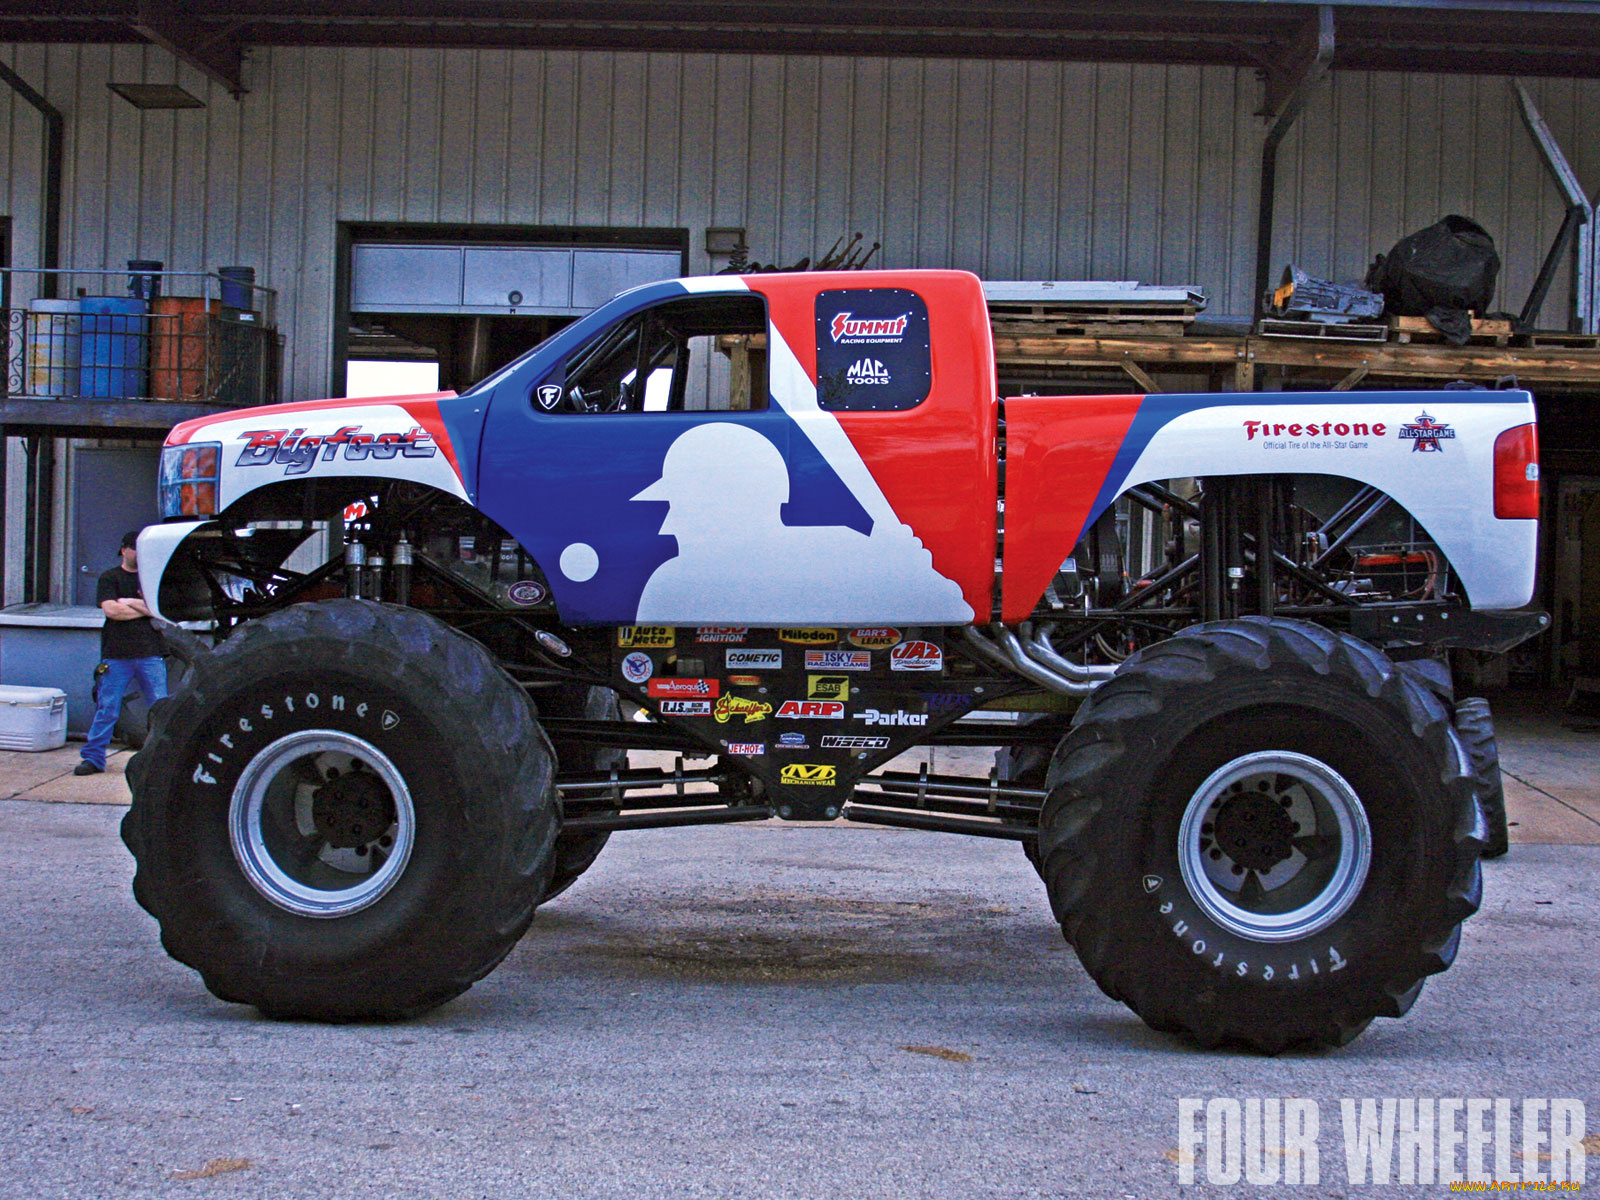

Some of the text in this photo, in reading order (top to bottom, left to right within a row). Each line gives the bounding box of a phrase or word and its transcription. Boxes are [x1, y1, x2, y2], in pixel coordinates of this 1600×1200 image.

[847, 358, 889, 377] MAC
[847, 377, 889, 385] TOOLS
[1243, 420, 1387, 441] Firestone
[1433, 428, 1454, 438] GAME
[235, 425, 437, 475] Bigfoot
[1263, 441, 1369, 450] Official Tire of the All-Star Game
[634, 626, 666, 635] Auto
[781, 628, 836, 640] Milodon
[856, 629, 888, 637] BAR'S
[632, 635, 673, 645] Meter
[699, 634, 744, 643] IGNITION
[861, 636, 892, 645] LEAKS
[892, 641, 941, 659] JAZ
[728, 653, 780, 663] COMETIC
[824, 653, 853, 662] ISKY
[815, 683, 841, 692] ESAB
[778, 702, 843, 716] ARP
[865, 709, 929, 726] Parker
[193, 692, 369, 784] Firestone
[728, 744, 760, 753] JET-HOT
[781, 777, 836, 786] MECHANIX WEAR
[1160, 902, 1347, 981] Firestone
